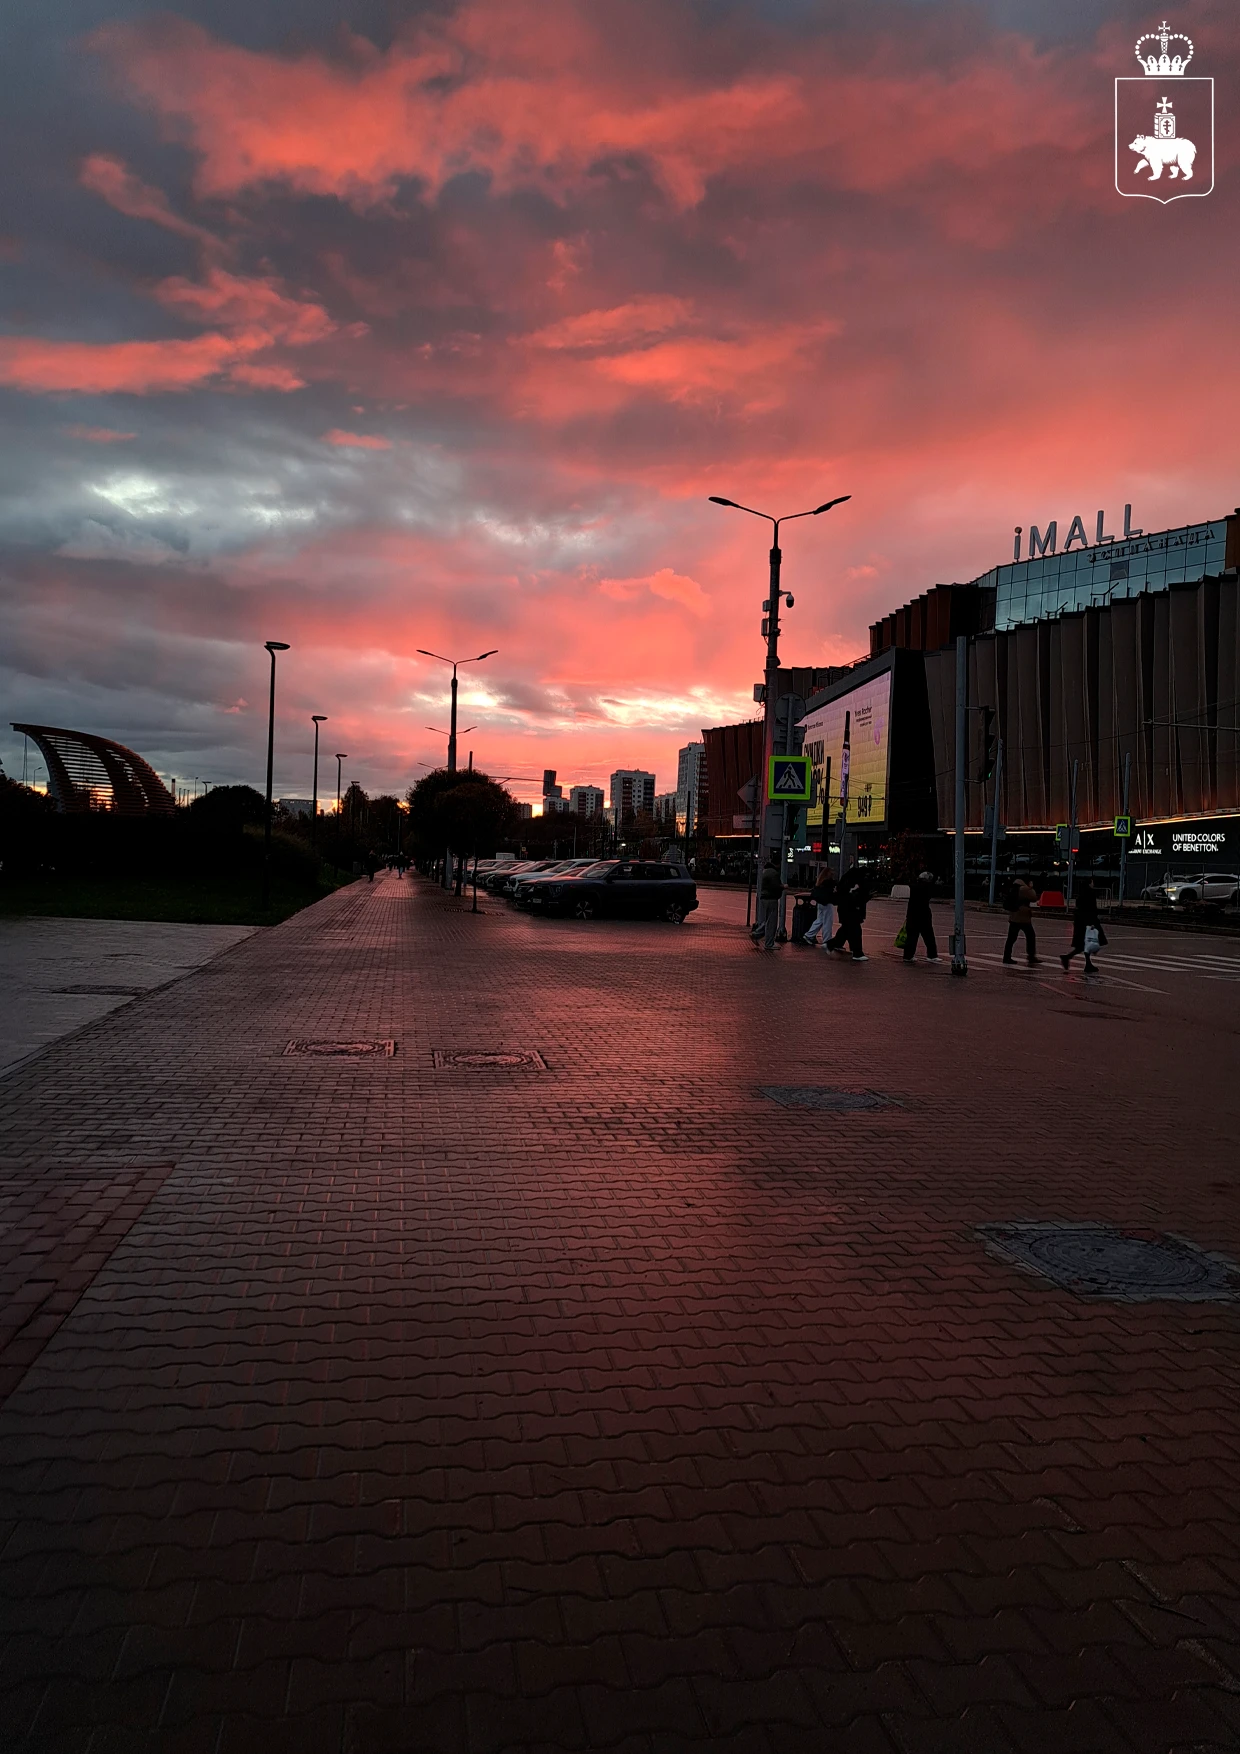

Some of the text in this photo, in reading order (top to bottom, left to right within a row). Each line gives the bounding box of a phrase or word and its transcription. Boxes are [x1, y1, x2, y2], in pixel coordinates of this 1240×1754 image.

[1014, 504, 1143, 560] iMALL
[1172, 833, 1226, 842] UNITED COLORS
[1172, 843, 1182, 852] OF
